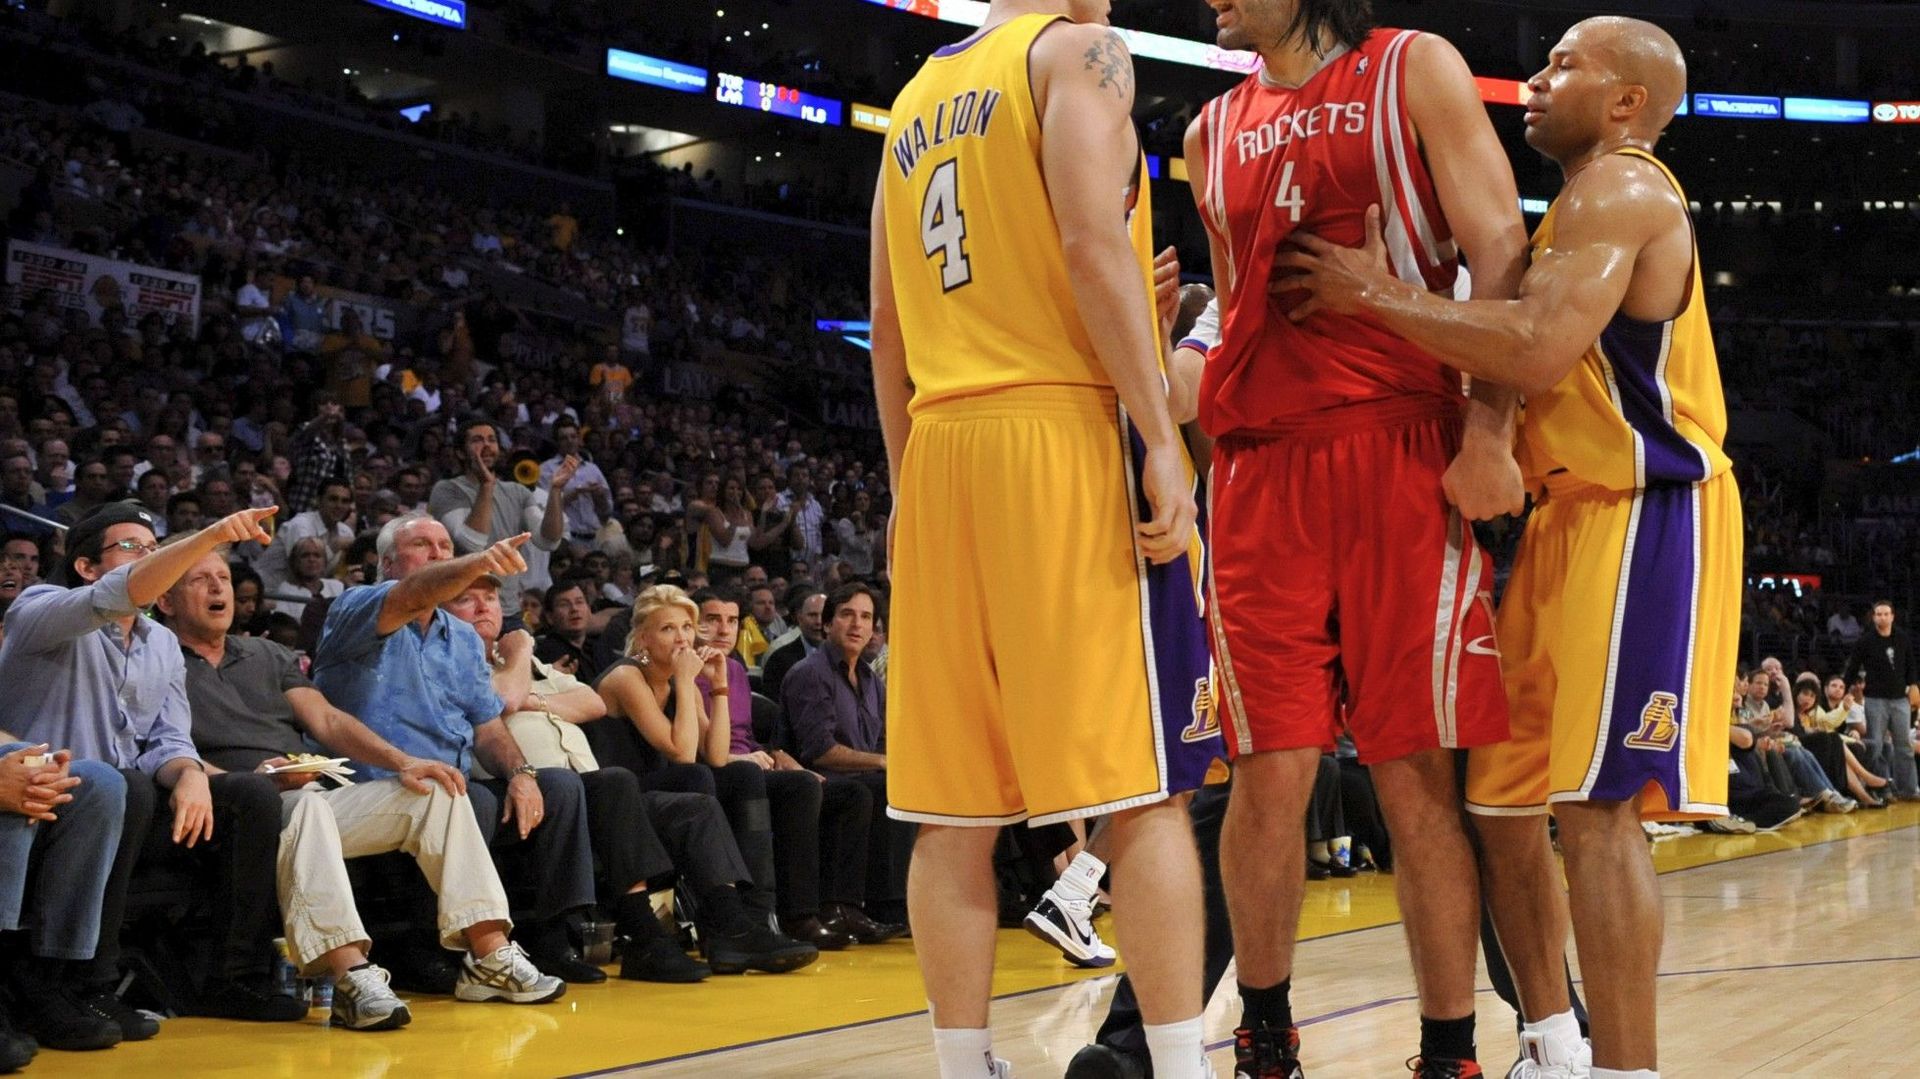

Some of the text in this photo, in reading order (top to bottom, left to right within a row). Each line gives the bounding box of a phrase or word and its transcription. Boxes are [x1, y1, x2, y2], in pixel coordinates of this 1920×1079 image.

[801, 105, 826, 124] MLB
[892, 88, 1001, 182] WALTON
[1233, 102, 1366, 166] ROCKETS
[1274, 161, 1305, 222] 4
[920, 157, 972, 294] 4
